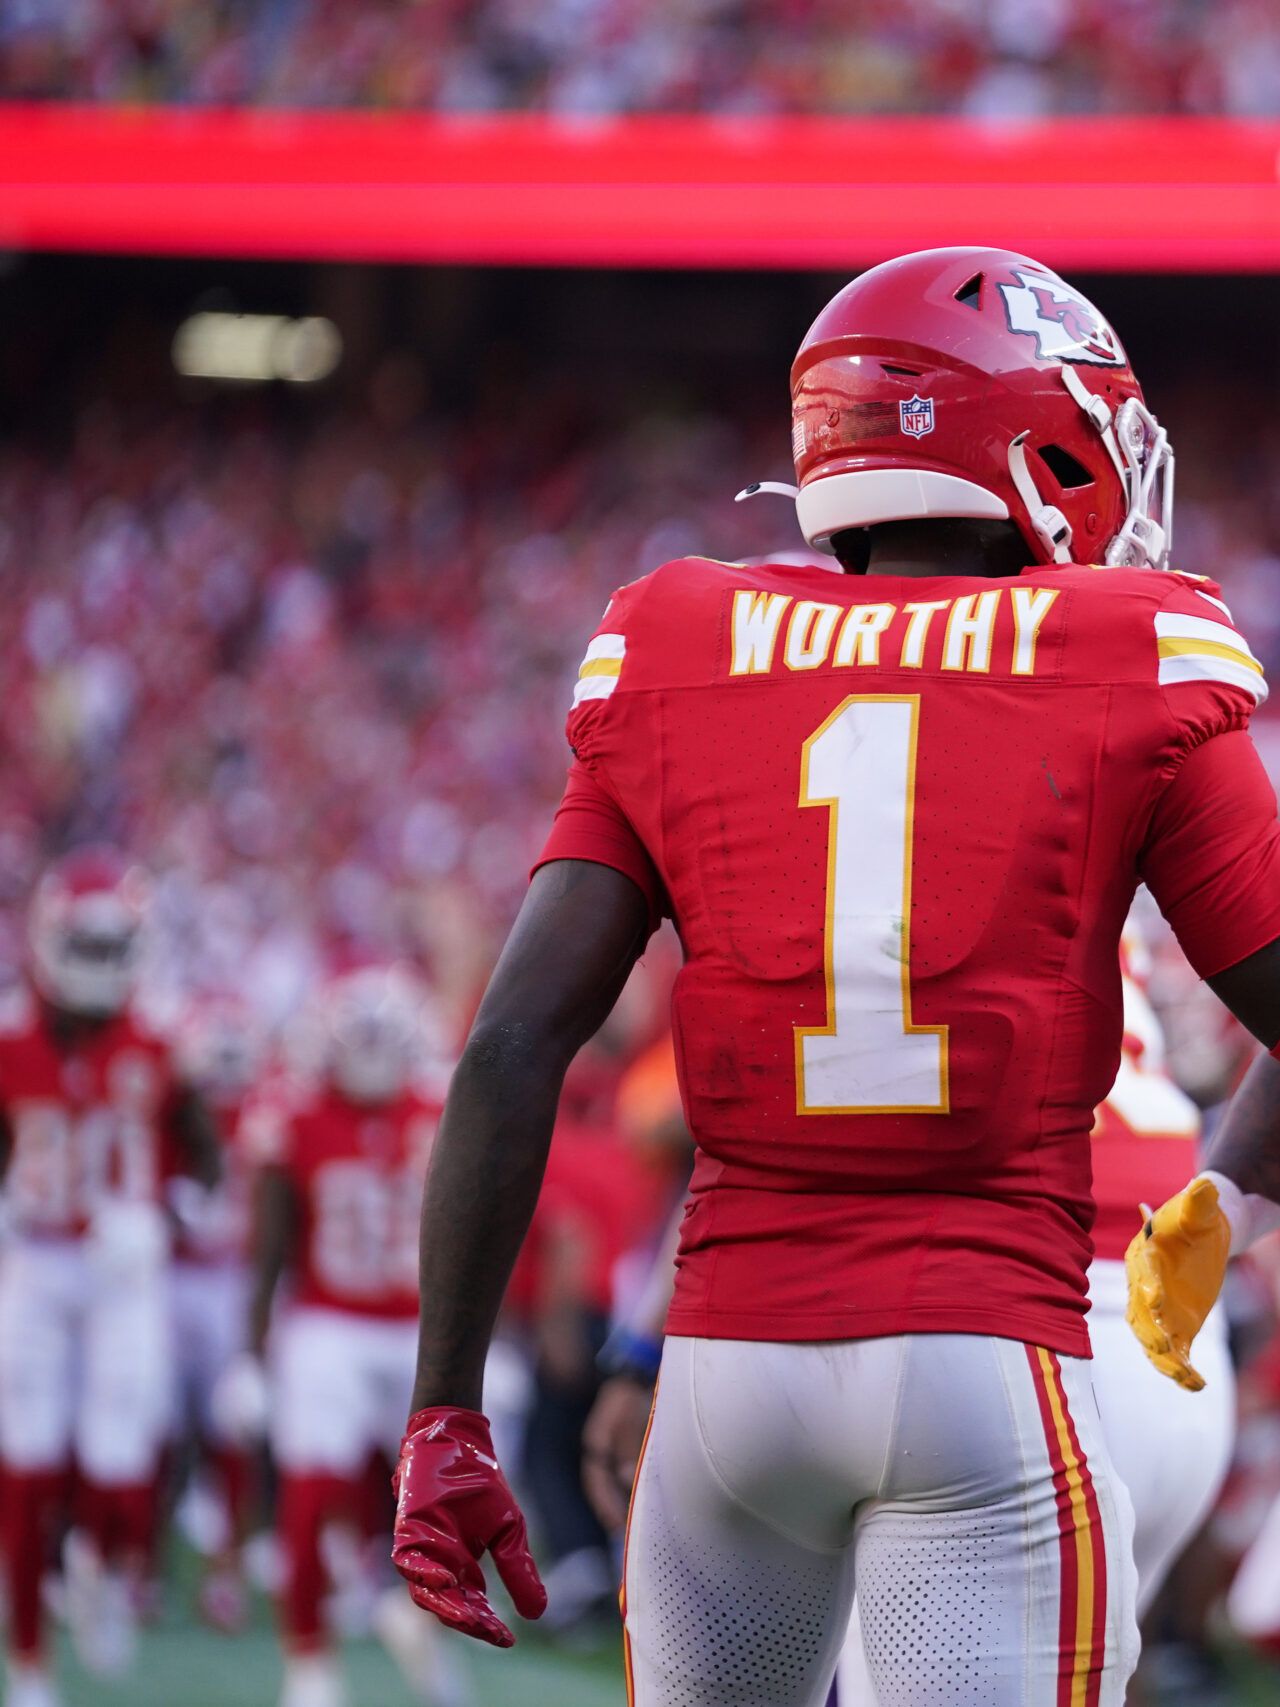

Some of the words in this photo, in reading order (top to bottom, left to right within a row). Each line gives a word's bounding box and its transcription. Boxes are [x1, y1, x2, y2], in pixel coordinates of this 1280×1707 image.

[905, 414, 930, 431] NFL
[728, 587, 1060, 676] WORTHY
[793, 693, 950, 1116] 1
